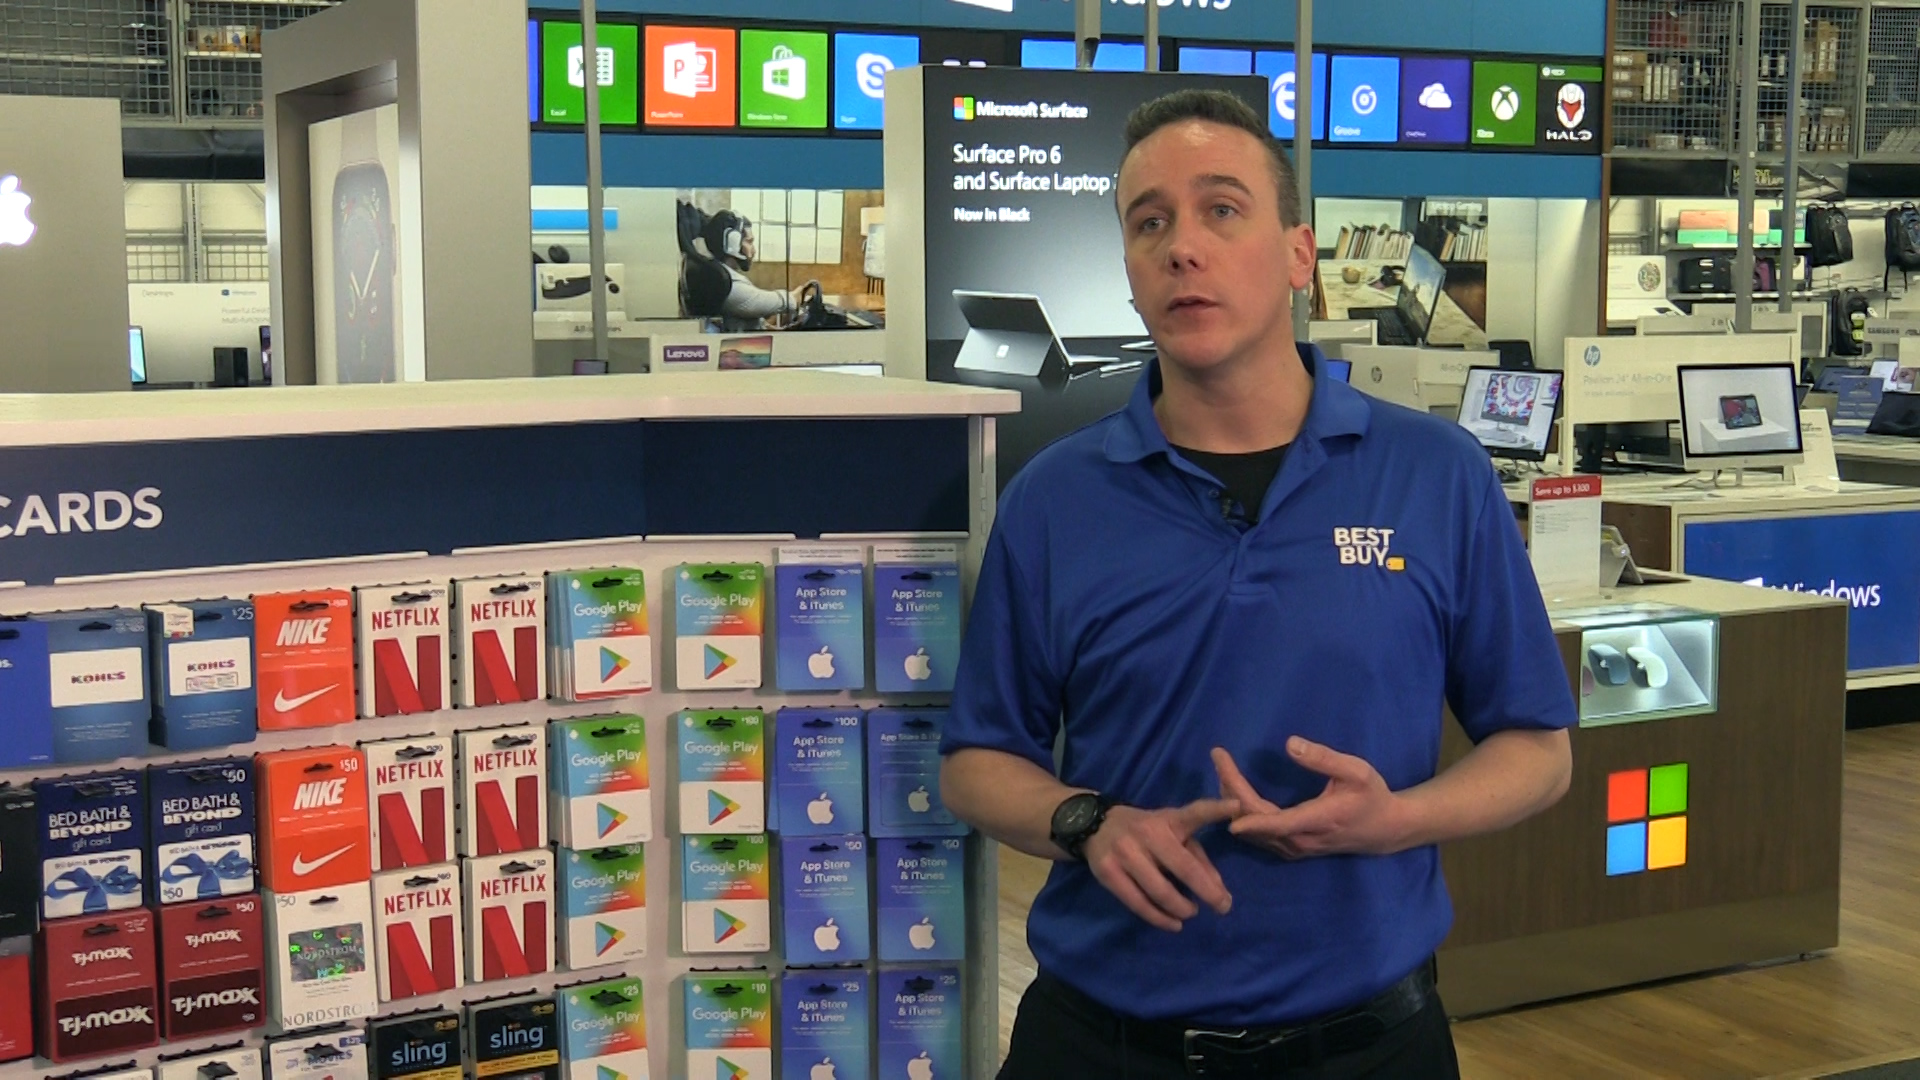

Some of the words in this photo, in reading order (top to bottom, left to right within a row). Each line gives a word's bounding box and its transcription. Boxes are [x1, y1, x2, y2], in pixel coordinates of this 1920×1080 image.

[976, 101, 1038, 118] Microsoft
[1039, 102, 1089, 119] Surface
[1546, 129, 1593, 141] HALO
[953, 143, 1016, 164] Surface
[1018, 144, 1048, 164] Pro
[1049, 144, 1062, 165] 6
[953, 171, 986, 191] and
[988, 171, 1051, 191] Surface
[1053, 172, 1111, 196] Laptop
[953, 207, 984, 222] Now
[999, 207, 1031, 222] Black
[666, 349, 706, 359] Lenovo
[1333, 527, 1395, 546] BEST
[1340, 546, 1389, 567] BUY
[680, 594, 727, 610] Google
[729, 593, 756, 608] Play
[795, 587, 818, 600] App
[818, 587, 847, 597] Store
[891, 589, 914, 602] App
[914, 589, 943, 599] Store
[232, 607, 254, 620] $25
[471, 599, 537, 623] NETFLIX
[574, 602, 617, 618] Google
[618, 600, 643, 614] Play
[799, 601, 808, 610] &
[809, 600, 845, 610] iTunes
[895, 603, 904, 612] &
[905, 602, 940, 612] iTunes
[371, 607, 441, 632] NETFLIX
[275, 617, 333, 647] NIKE
[835, 717, 858, 726] $100
[684, 742, 731, 756] Google
[732, 741, 759, 756] Play
[793, 736, 816, 749] App
[816, 735, 845, 745] Store
[340, 757, 358, 772] $50
[474, 748, 538, 774] NETFLIX
[571, 752, 616, 767] Google
[616, 749, 642, 763] Play
[376, 759, 444, 786] NETFLIX
[162, 798, 190, 815] BED
[191, 793, 228, 811] BATH
[229, 791, 240, 806] &
[293, 777, 347, 811] NIKE
[48, 811, 78, 828] BED
[79, 807, 118, 825] BATH
[119, 805, 131, 819] &
[163, 806, 242, 826] BEYOND
[49, 820, 132, 840] BEYOND
[690, 861, 736, 875] Google
[738, 859, 764, 873] Play
[801, 861, 822, 871] App
[823, 860, 850, 870] Store
[897, 858, 918, 869] App
[919, 857, 947, 868] Store
[480, 873, 547, 899] NETFLIX
[572, 874, 616, 889] Google
[616, 870, 642, 883] Play
[163, 887, 183, 899] $50
[384, 887, 452, 915] NETFLIX
[236, 901, 255, 912] $50
[752, 983, 767, 994] $10
[797, 1001, 819, 1011] App
[820, 999, 848, 1009] Store
[895, 994, 915, 1004] App
[917, 993, 945, 1002] Store
[283, 1004, 363, 1028] NORDSTRO
[571, 1014, 614, 1031] Google
[616, 1011, 640, 1023] Play
[692, 1007, 738, 1022] Google
[740, 1007, 766, 1021] Play
[811, 1012, 845, 1022] iTunes
[490, 1025, 544, 1048] sling
[392, 1041, 447, 1066] sling
